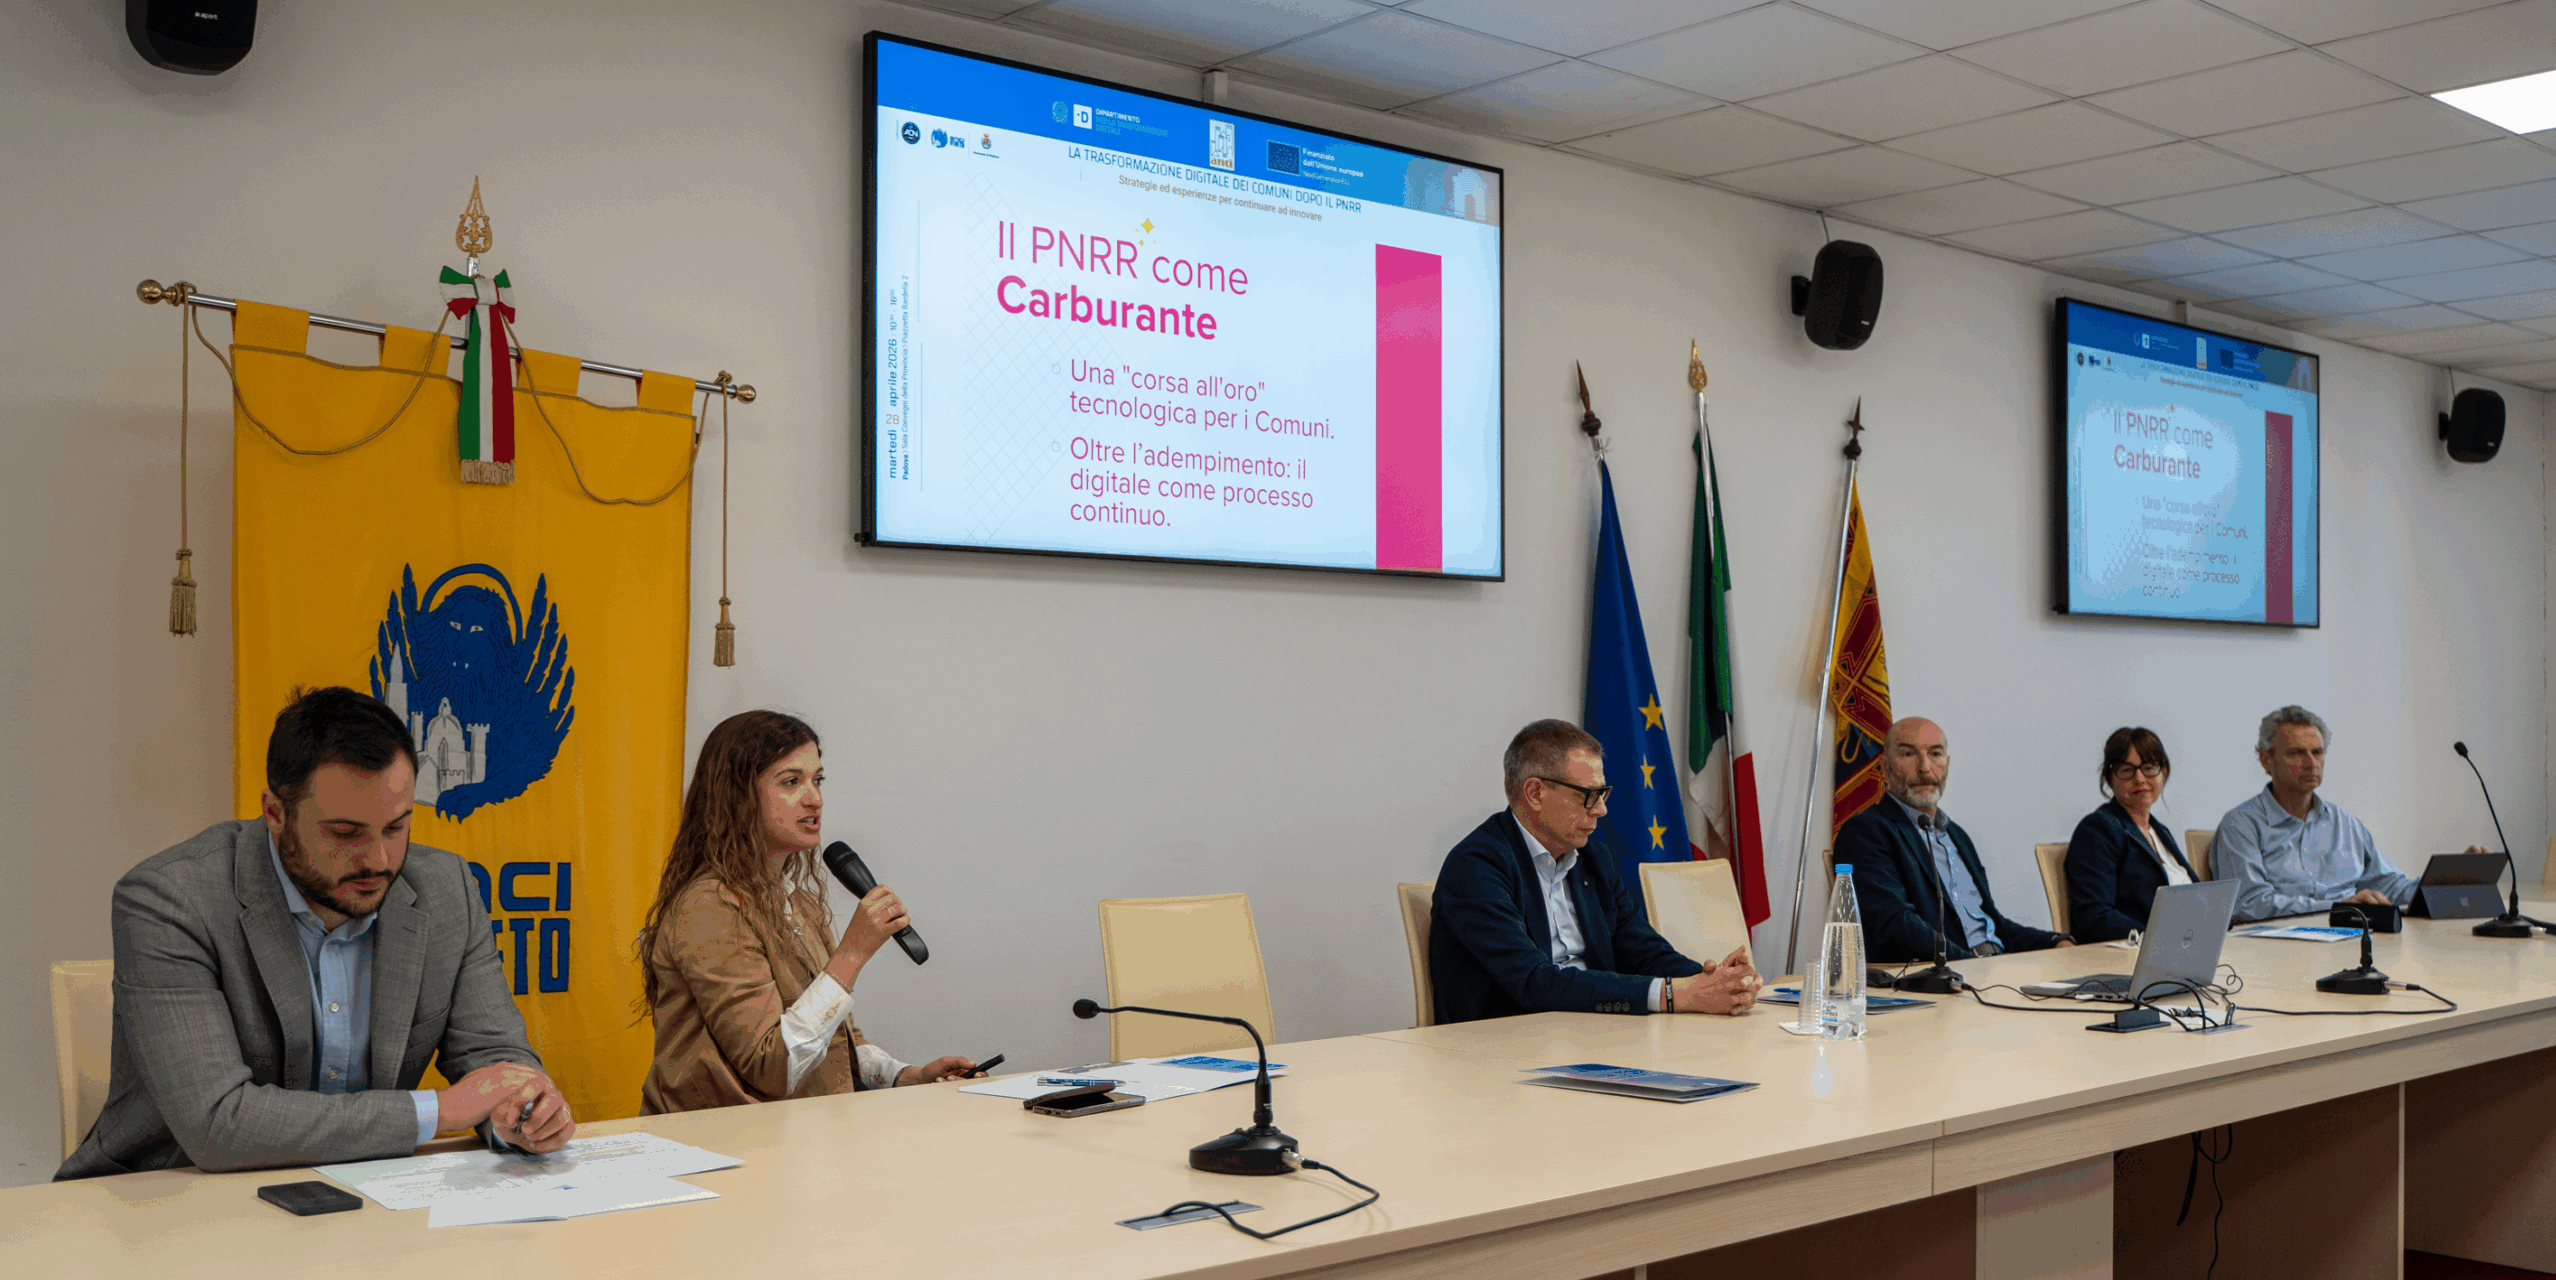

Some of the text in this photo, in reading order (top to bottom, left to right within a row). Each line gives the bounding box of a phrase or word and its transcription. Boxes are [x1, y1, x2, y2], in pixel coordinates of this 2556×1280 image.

[1068, 145, 1362, 214] LA TRASFORMAZIONE DIGITALE DEI COMUNI DOPO IL PNRR
[1210, 157, 1233, 169] anci
[1118, 174, 1322, 222] Strategie ed esperienze per continuare ad innovare
[999, 221, 1249, 295] Il PNRR come
[997, 275, 1217, 340] Carburante
[888, 338, 898, 369] 2026
[887, 371, 899, 407] aprile
[1071, 359, 1265, 402] Una "corsa all'oro"
[901, 400, 909, 433] Convegni
[1070, 391, 1197, 427] tecnologica
[1204, 408, 1238, 431] per
[1255, 410, 1335, 440] Comuni.
[2127, 412, 2168, 442] PNRR
[2174, 426, 2214, 450] come
[1070, 436, 1125, 463] Oltre
[1297, 458, 1307, 480] il
[2114, 443, 2201, 479] Carburante
[1070, 468, 1314, 508] digitale come processo
[1070, 502, 1171, 527] continuo.
